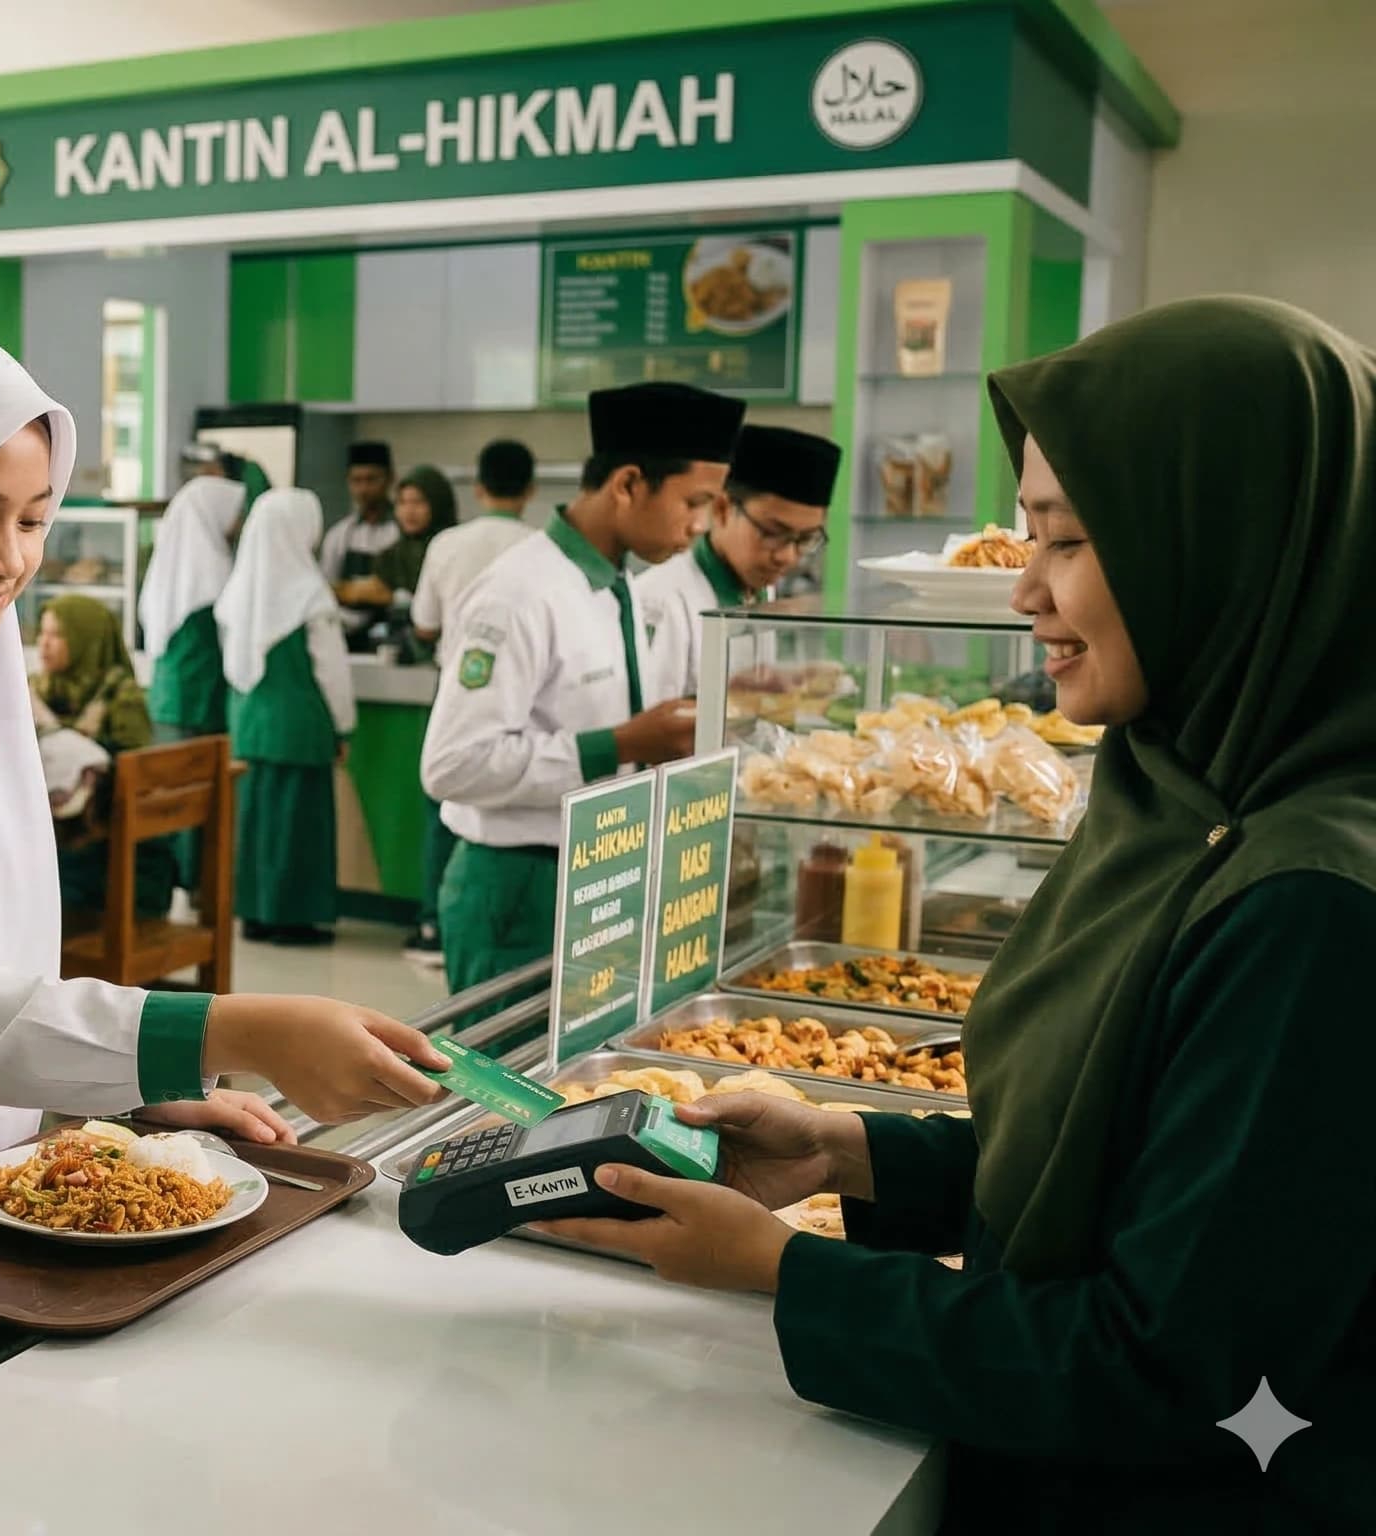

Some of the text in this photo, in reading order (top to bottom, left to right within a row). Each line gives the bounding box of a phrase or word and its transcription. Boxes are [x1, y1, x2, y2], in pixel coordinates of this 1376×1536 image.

[55, 73, 735, 197] KANTIN AL-HIKMAH
[830, 106, 898, 124] HALAL
[572, 822, 645, 871] AL-HIKMAH
[665, 934, 710, 982] HALAL
